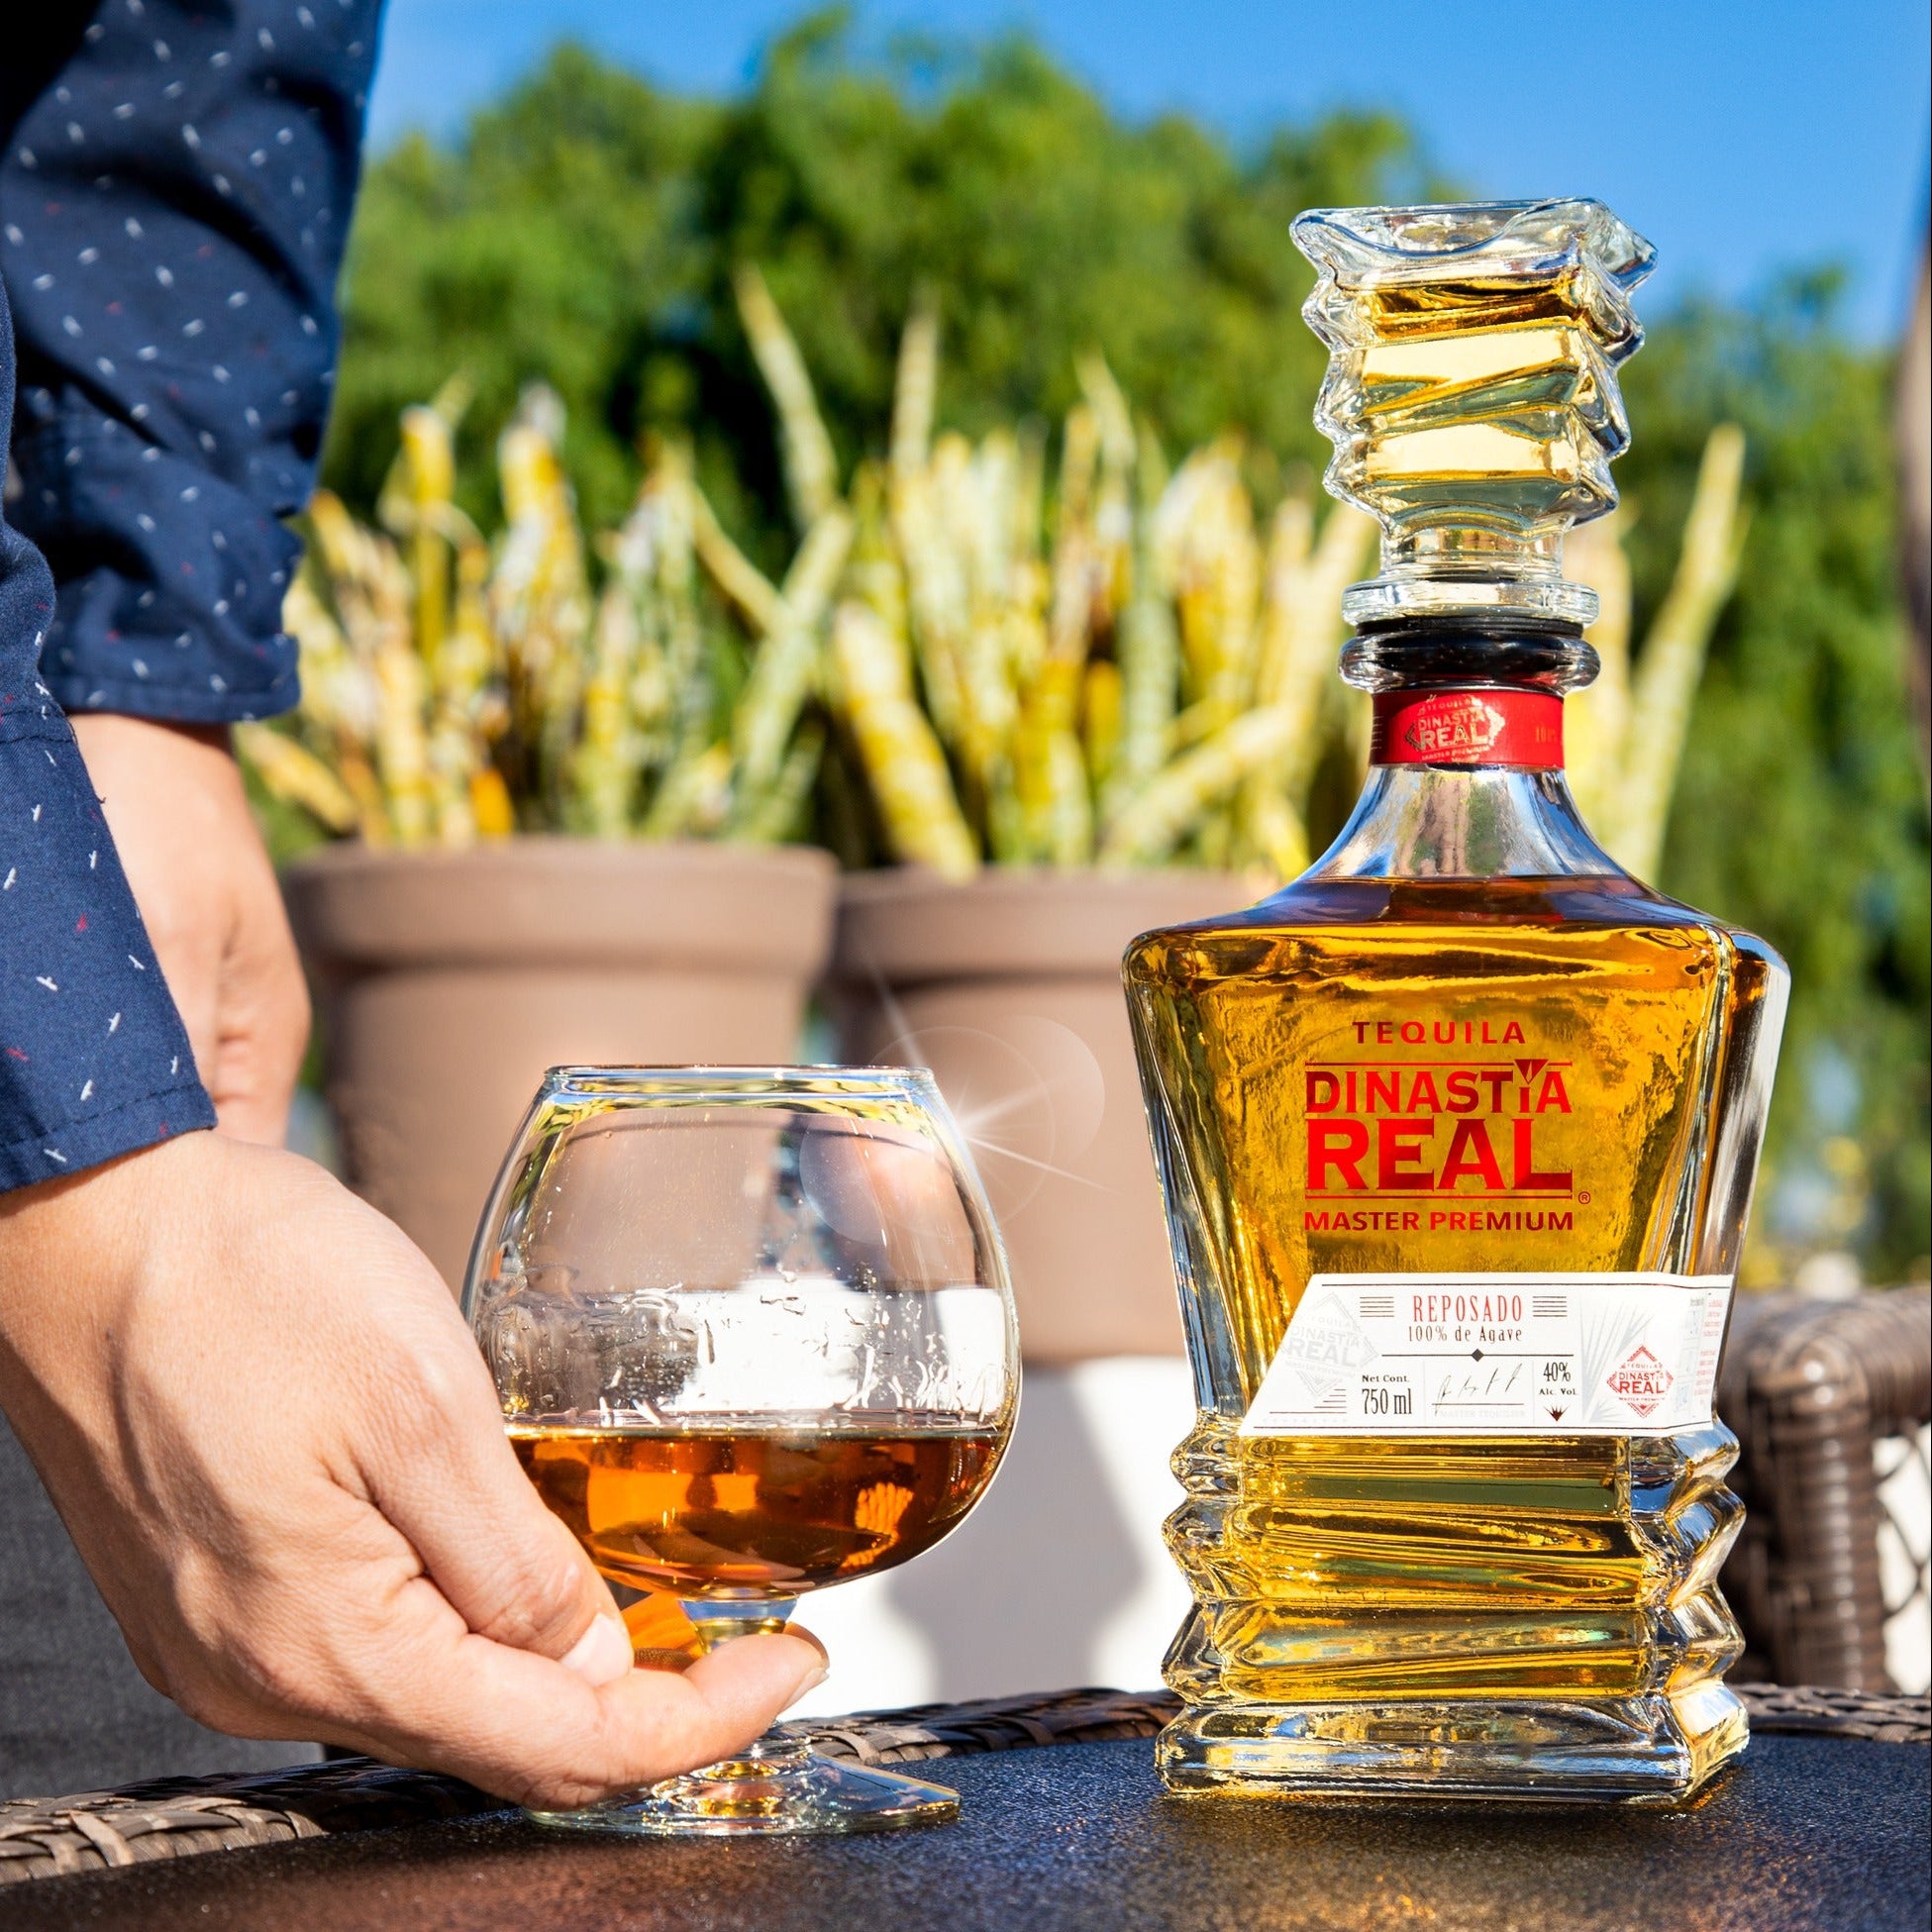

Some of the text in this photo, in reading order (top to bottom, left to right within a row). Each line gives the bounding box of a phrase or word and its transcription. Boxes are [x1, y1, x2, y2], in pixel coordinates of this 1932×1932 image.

[1419, 722, 1489, 751] REAL
[1352, 1021, 1526, 1045] TEQUILA
[1305, 1115, 1574, 1192] REAL
[1304, 1211, 1574, 1231] MASTER PREMIUM
[1413, 1294, 1522, 1323] REPOSADO
[1408, 1325, 1522, 1345] 100% de Agave
[1288, 1336, 1357, 1368] REAL
[1362, 1374, 1379, 1383] Net
[1543, 1362, 1572, 1382] 40%
[1619, 1380, 1665, 1394] REAL
[1362, 1387, 1412, 1415] 750 ml
